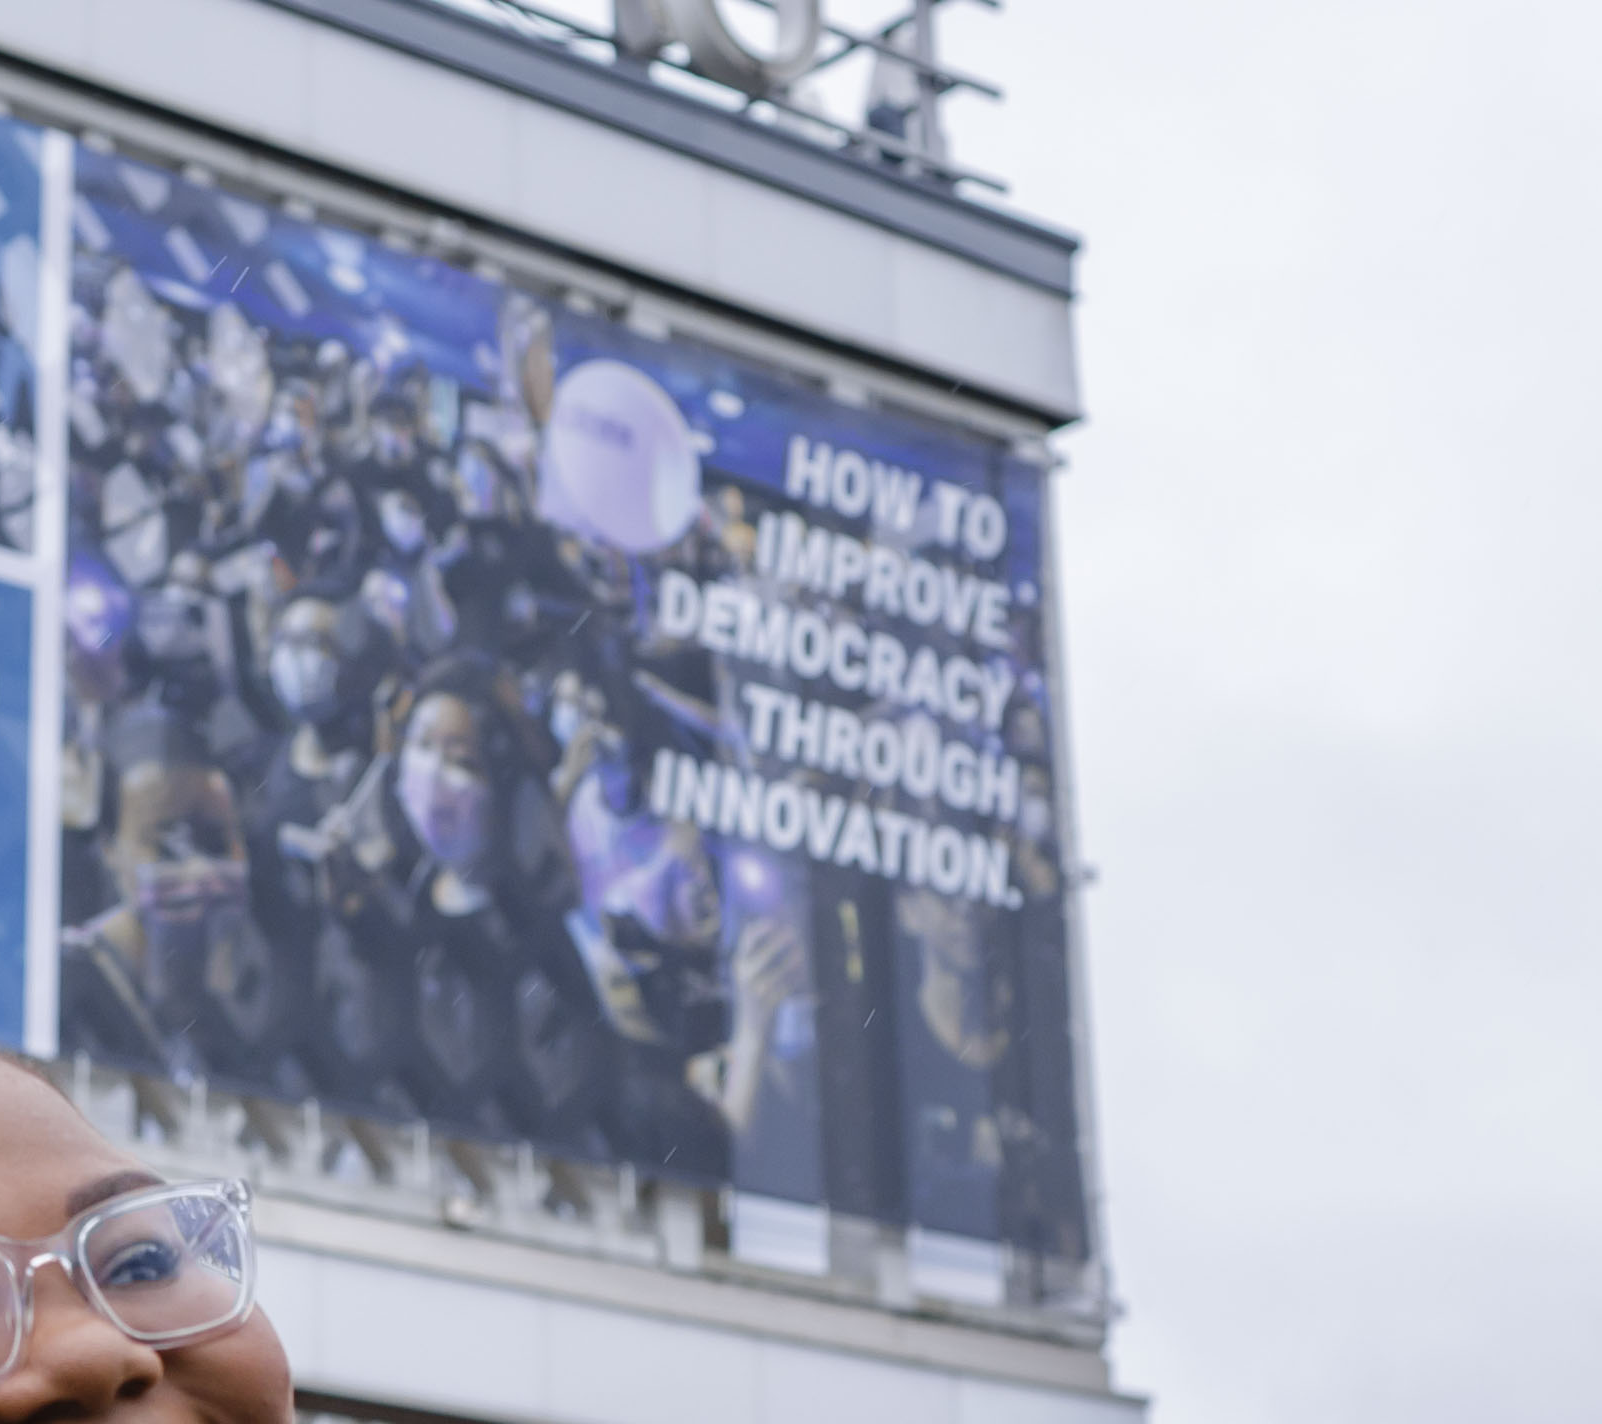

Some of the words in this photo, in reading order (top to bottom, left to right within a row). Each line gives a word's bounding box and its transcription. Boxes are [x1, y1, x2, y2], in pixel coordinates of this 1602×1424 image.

[784, 434, 924, 533] HOW
[929, 479, 1009, 560] TO
[658, 568, 1016, 728] DEMOCRACY
[756, 510, 1013, 648] IMPROVE
[741, 681, 1021, 822] THROUGH
[649, 749, 1025, 910] INNOVATION.
